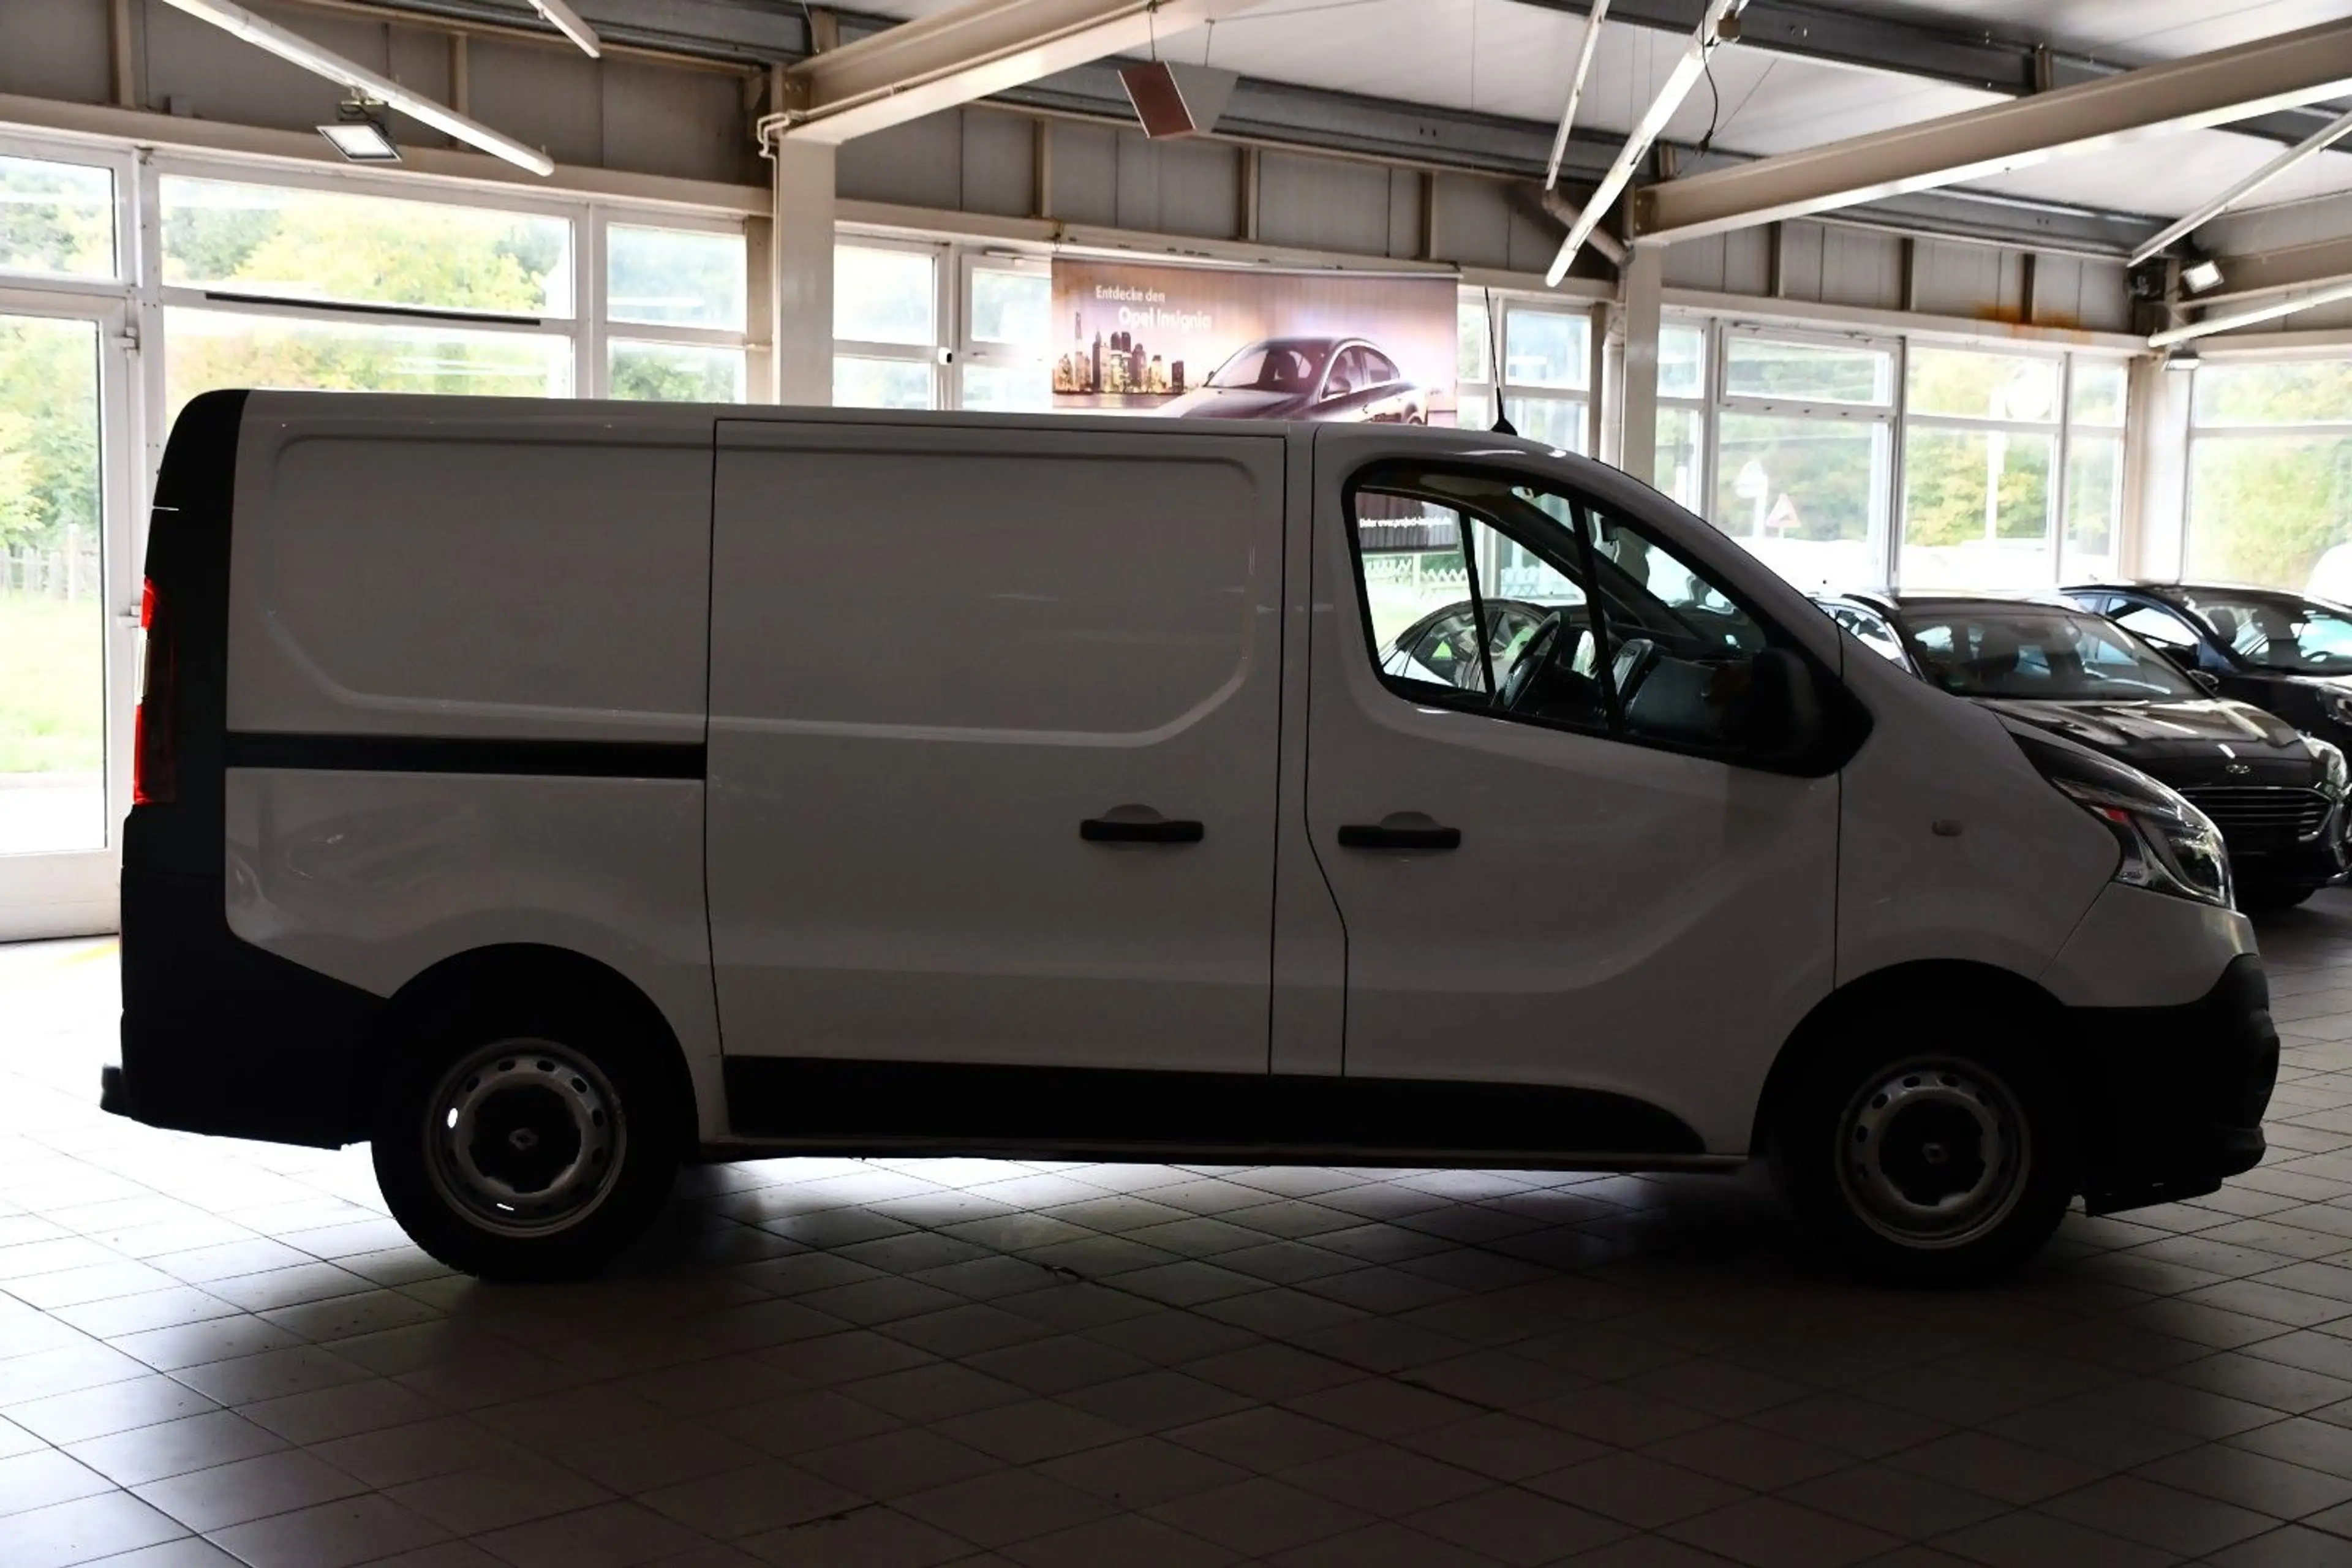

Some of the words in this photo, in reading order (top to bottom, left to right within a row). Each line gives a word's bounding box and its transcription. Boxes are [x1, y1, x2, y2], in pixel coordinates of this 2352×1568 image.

[1096, 285, 1143, 301] Entdecke
[1145, 288, 1166, 302] den
[1118, 306, 1154, 329] Opel
[1157, 309, 1212, 332] Insignia
